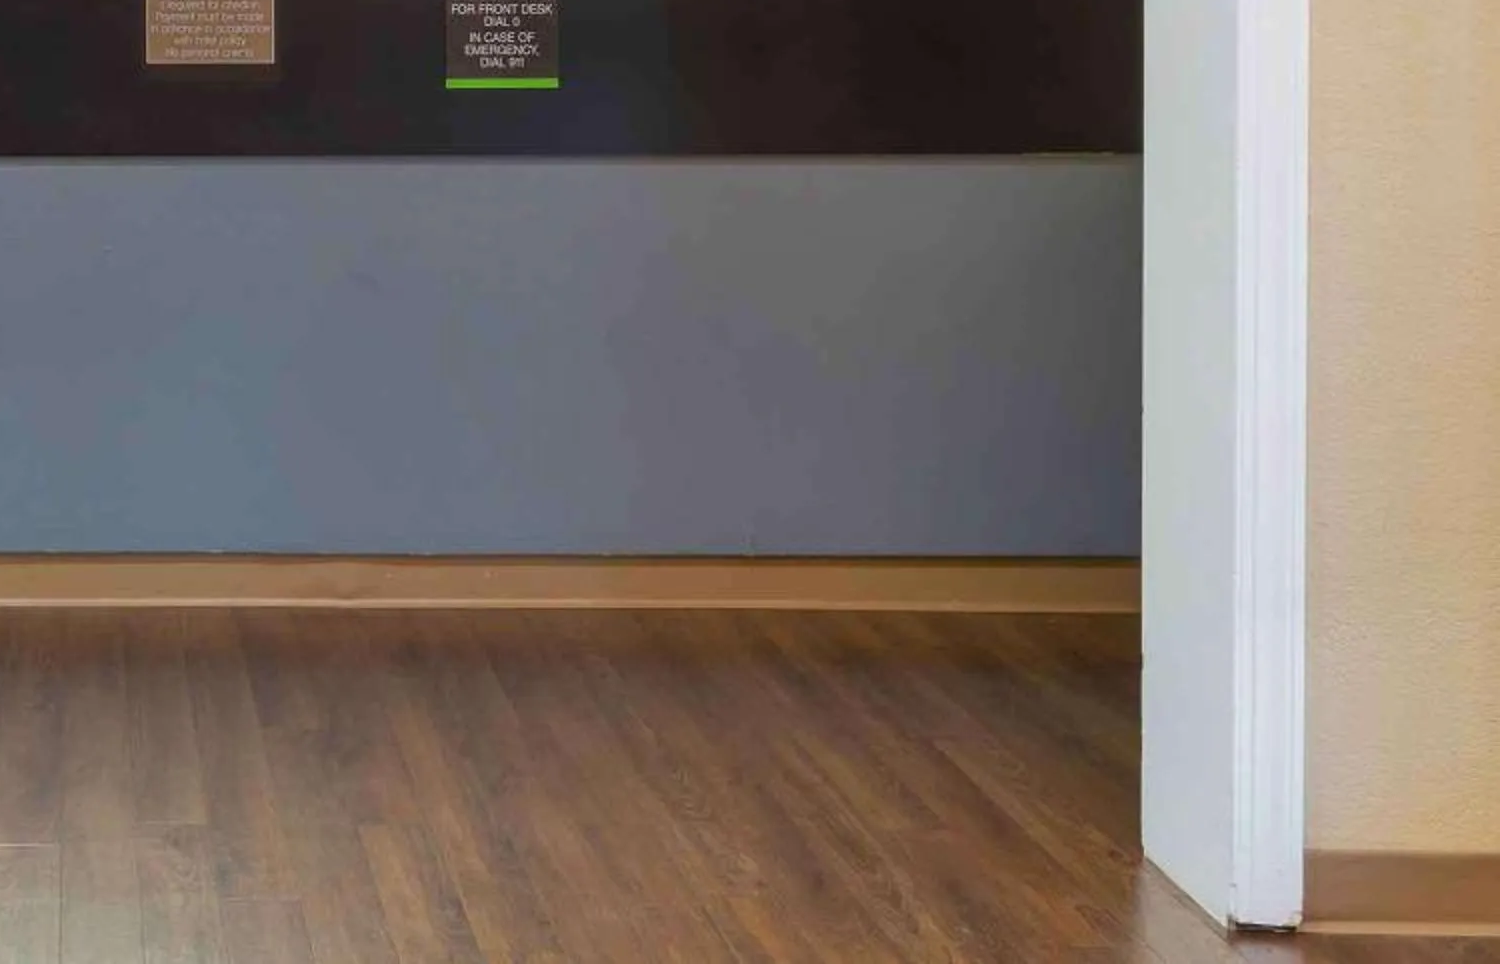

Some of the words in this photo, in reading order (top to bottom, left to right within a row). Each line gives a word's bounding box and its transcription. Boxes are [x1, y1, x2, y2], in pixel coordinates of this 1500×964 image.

[451, 3, 476, 15] FOR
[479, 3, 518, 15] FRONT
[521, 3, 553, 15] DESK
[484, 16, 510, 27] DIAL
[469, 31, 481, 43] IN
[483, 31, 515, 43] CASE
[518, 31, 536, 43] OF
[479, 57, 506, 69] DIAL
